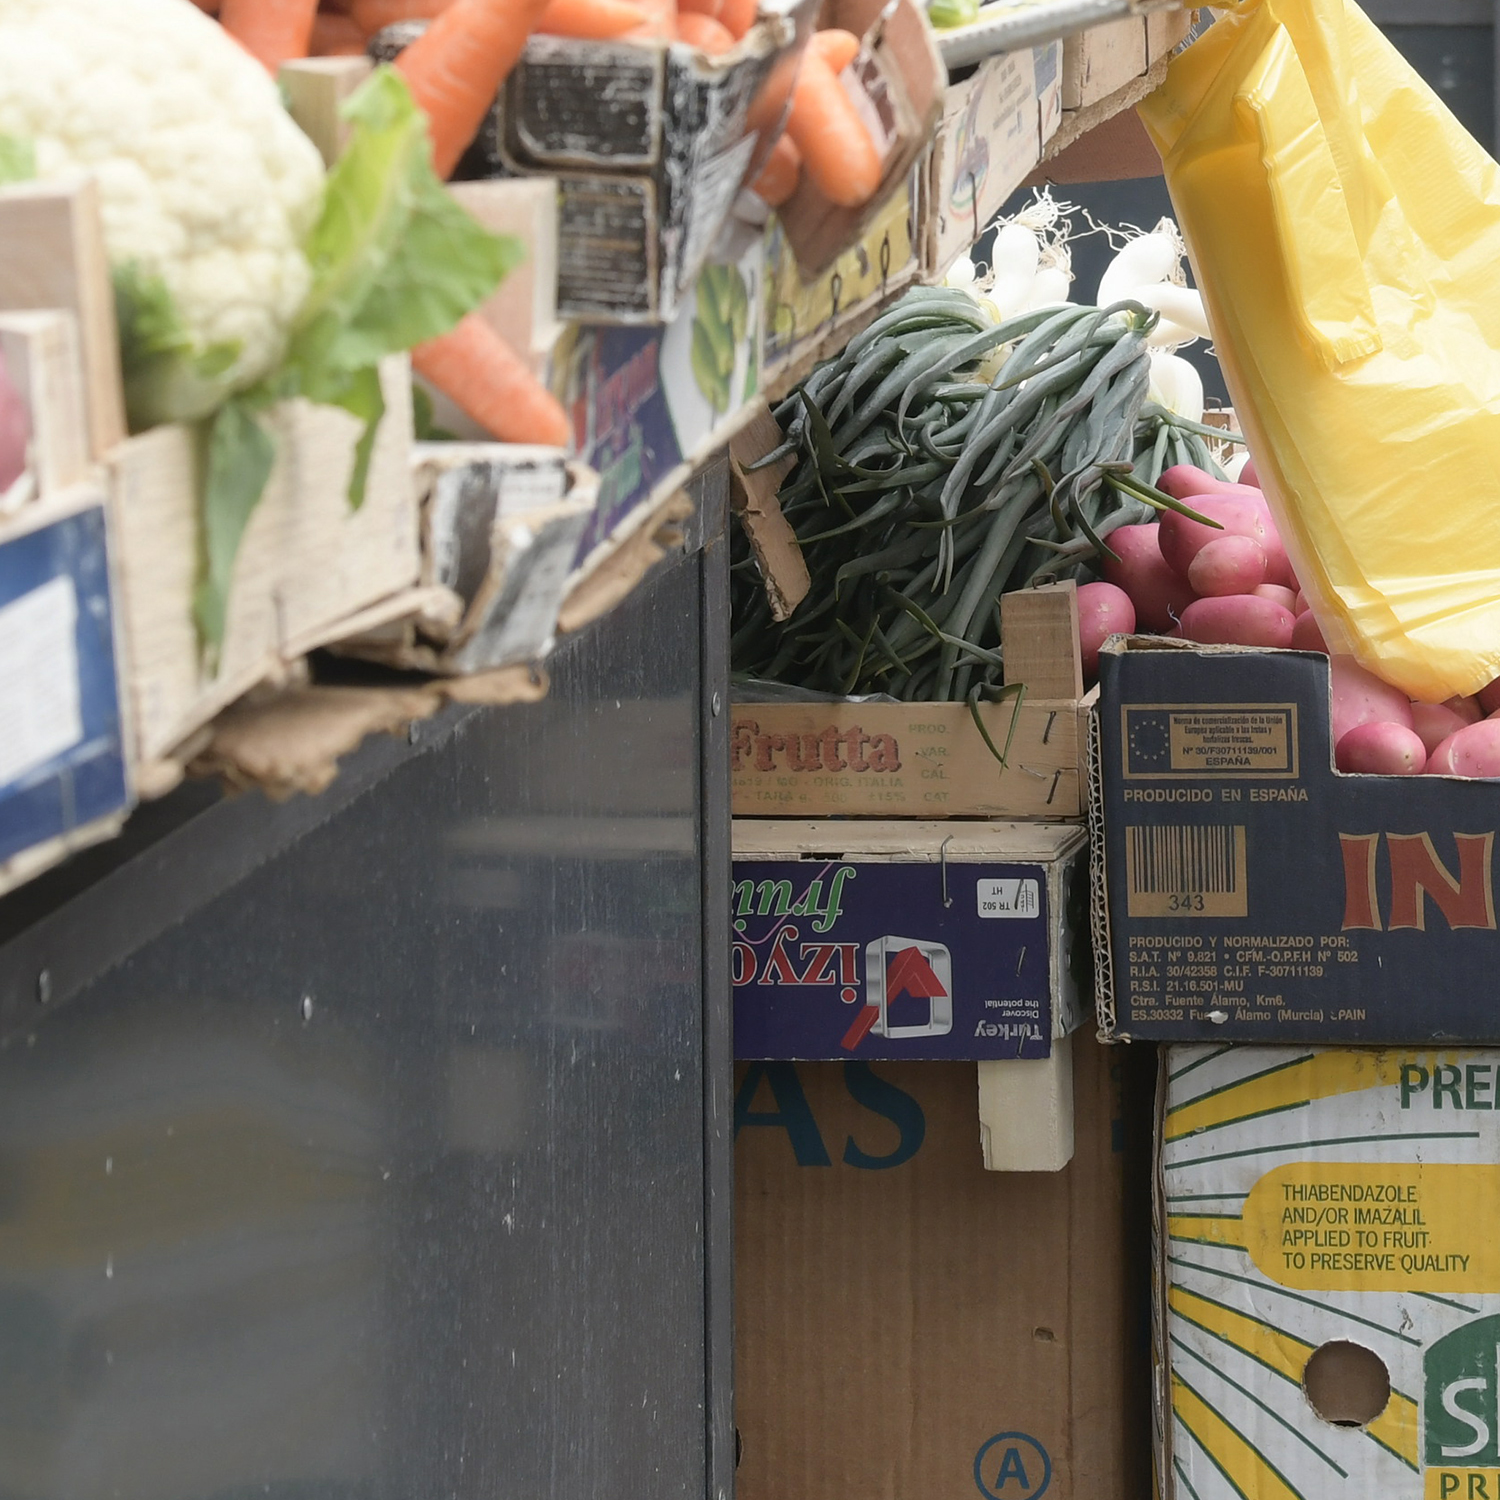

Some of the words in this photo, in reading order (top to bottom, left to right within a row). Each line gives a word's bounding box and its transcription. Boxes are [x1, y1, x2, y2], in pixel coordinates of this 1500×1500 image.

[1206, 755, 1251, 766] ESPAÑA
[858, 776, 904, 788] ITALIA
[1123, 788, 1213, 802] PRODUCIDO
[1221, 788, 1242, 801] EN
[1250, 785, 1309, 802] ESPAÑA
[992, 886, 1003, 895] HT
[982, 901, 997, 911] 502
[999, 901, 1010, 910] TR
[1168, 894, 1205, 912] 343
[1129, 936, 1203, 948] PRODUCIDO
[1209, 936, 1218, 947] Y
[1223, 936, 1314, 948] NORMALIZADO
[1320, 936, 1350, 948] POR:
[1129, 951, 1161, 963] S.A.T.
[1187, 951, 1217, 962] 9.821
[1337, 951, 1358, 963] 502
[1130, 966, 1160, 977] R.I.A.
[1166, 966, 1218, 977] 30/42358
[1223, 966, 1251, 977] C.I.F.
[1258, 966, 1324, 977] F-30711139
[1130, 981, 1160, 992] R.S.I.
[1166, 981, 1244, 992] 21.16.501-MU
[985, 998, 1023, 1009] potential
[1024, 999, 1039, 1008] the
[1130, 995, 1159, 1006] Ctra.
[1165, 995, 1204, 1006] Fuente
[1210, 993, 1251, 1007] Álamo,
[1256, 995, 1286, 1006] Km6.
[1002, 1010, 1039, 1019] Discover
[1131, 1009, 1184, 1021] ES.30332
[1234, 1007, 1271, 1021] Álamo
[1277, 1009, 1324, 1022] (Murcia)
[974, 1020, 1043, 1040] Turkey
[1282, 1184, 1418, 1202] THIABENDAZOLE
[1282, 1207, 1348, 1227] AND/OR
[1354, 1207, 1426, 1225] IMAZALIL
[1282, 1230, 1350, 1247] APPLIED
[1356, 1230, 1378, 1248] TO
[1383, 1231, 1430, 1248] FRUIT
[1283, 1252, 1306, 1270] TO
[1310, 1253, 1396, 1270] PRESERVE
[1400, 1253, 1470, 1274] QUALITY
[994, 1447, 1030, 1490] A
